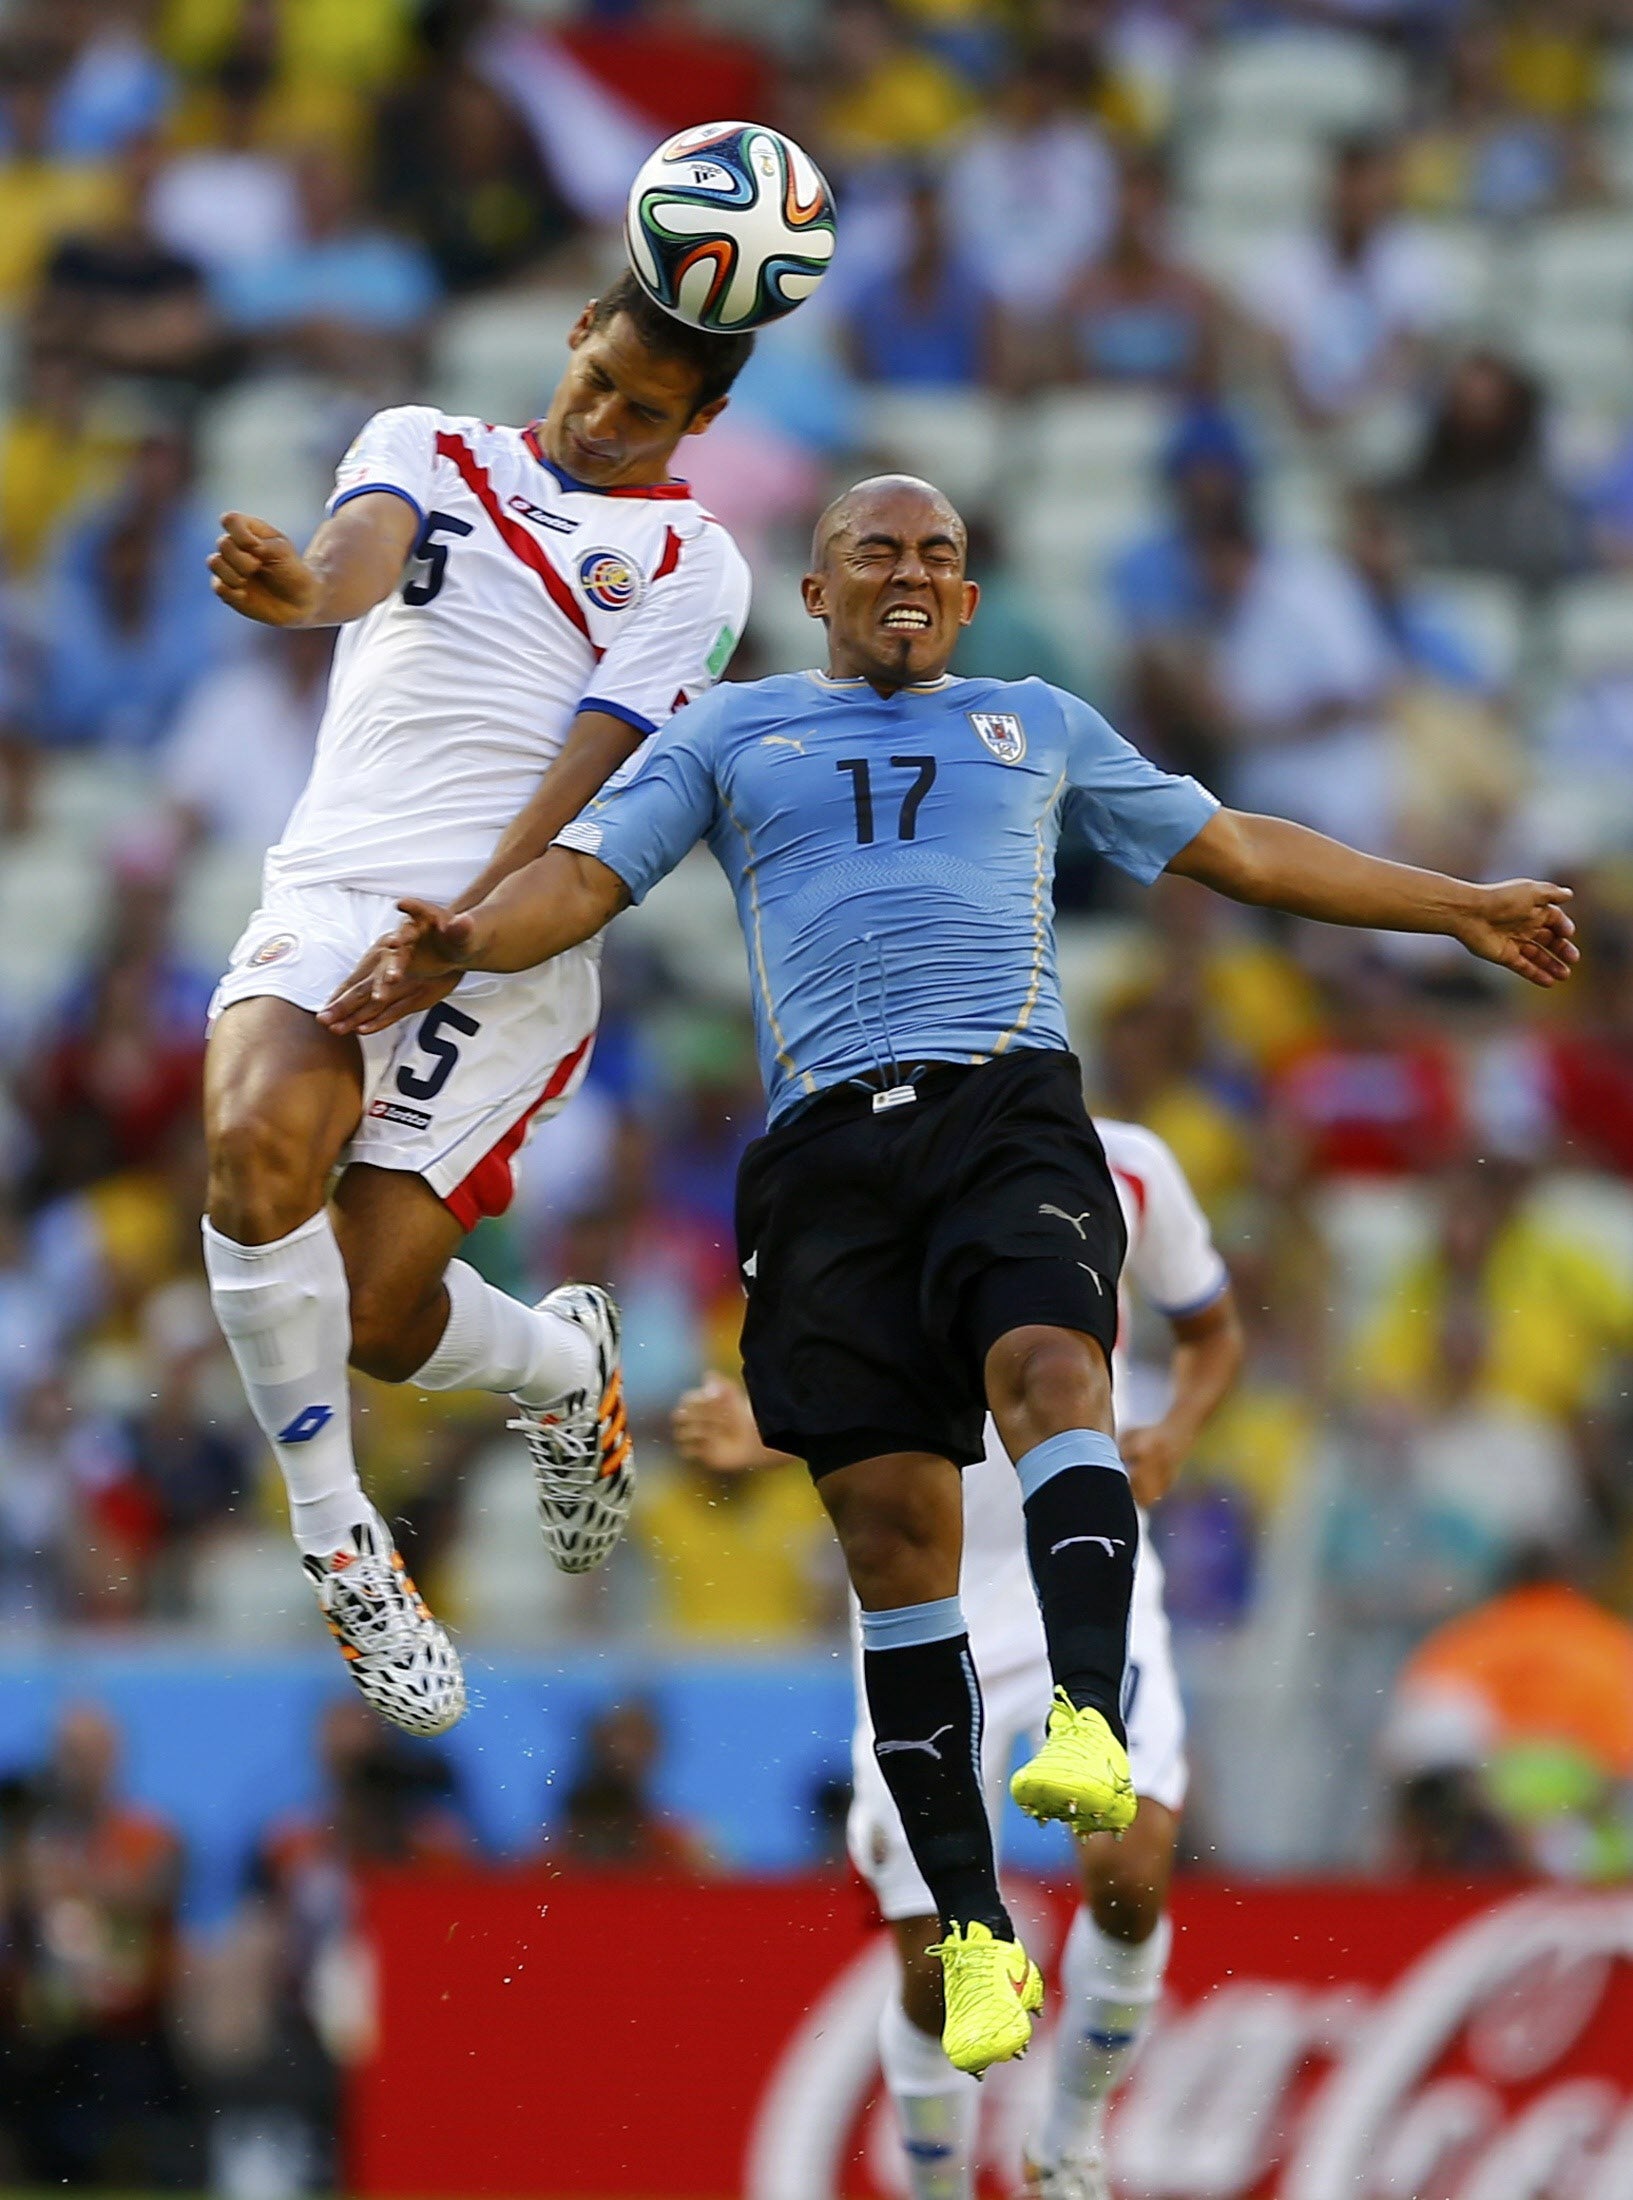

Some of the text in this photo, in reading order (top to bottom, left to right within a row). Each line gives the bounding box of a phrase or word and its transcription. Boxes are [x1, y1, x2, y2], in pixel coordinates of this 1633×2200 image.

[402, 511, 473, 606] 5
[837, 756, 936, 844] 17
[397, 1001, 480, 1100] 5
